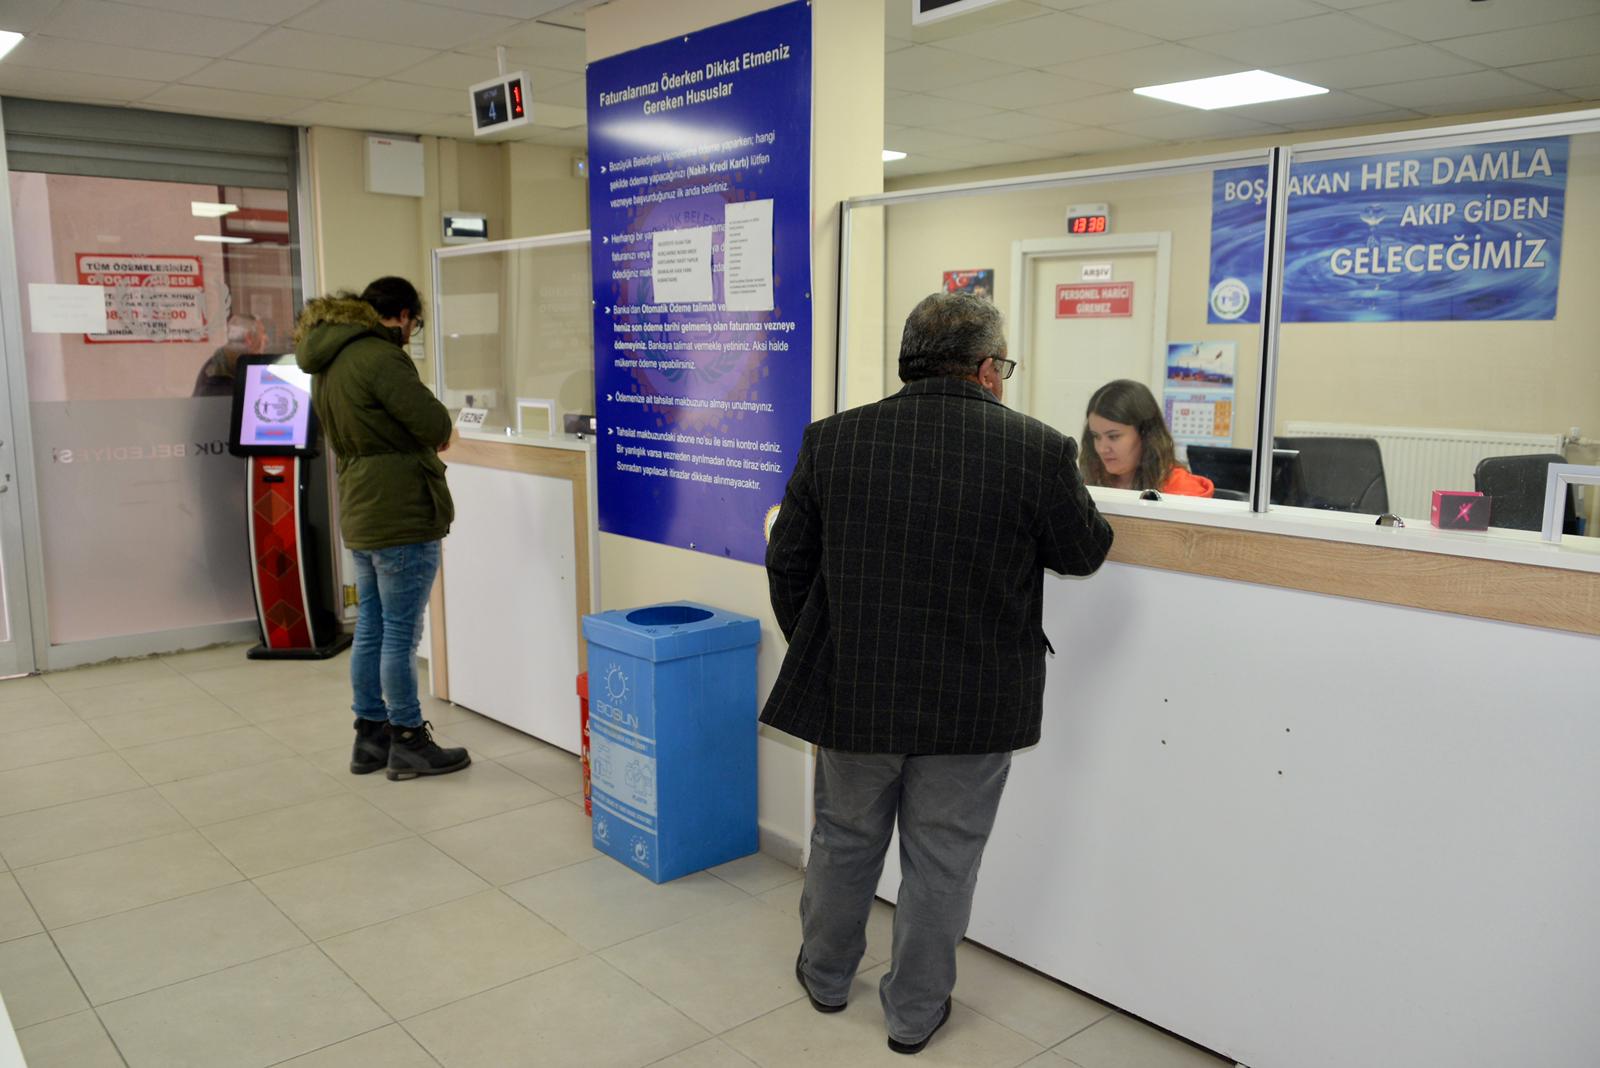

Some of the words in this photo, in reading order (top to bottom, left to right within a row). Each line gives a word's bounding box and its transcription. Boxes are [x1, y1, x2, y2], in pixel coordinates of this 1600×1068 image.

[600, 81, 659, 107] Faturalarınızı
[661, 70, 703, 91] Öderken
[706, 57, 740, 79] Dikkat
[743, 43, 790, 69] Etmeniz
[644, 95, 683, 115] Gereken
[686, 82, 733, 105] Hususlar
[489, 101, 496, 120] 4
[755, 129, 776, 144] hangi
[710, 159, 728, 173] Kredi
[750, 153, 770, 167] lütfen
[1225, 178, 1269, 205] BOŞ
[1287, 171, 1350, 196] AKAN
[1361, 159, 1421, 191] HER
[1432, 148, 1553, 186] DAMLA
[685, 185, 700, 197] anda
[1400, 203, 1456, 227] AKIP
[1464, 193, 1549, 224] GİDEN
[636, 231, 644, 242] bir
[637, 250, 650, 262] veya
[1330, 232, 1546, 276] GELECEĞİMİZ
[1060, 289, 1099, 300] PERSONEL
[642, 303, 668, 314] Otomatik
[669, 302, 691, 313] Ödeme
[632, 323, 642, 332] son
[643, 322, 663, 332] ödeme
[664, 321, 680, 332] tarihi
[681, 321, 712, 333] gelmemiş
[713, 321, 728, 331] olan
[764, 321, 795, 333] vezneye
[648, 340, 672, 352] Bankaya
[673, 340, 693, 351] talimat
[752, 341, 767, 351] Aksi
[769, 340, 789, 352] halde
[638, 358, 657, 368] ödeme
[615, 391, 645, 403] Ödemenize
[654, 395, 674, 405] tahsilat
[675, 395, 708, 408] makbuzunu
[710, 399, 730, 411] almayı
[732, 401, 774, 413] unutmayınız.
[616, 426, 636, 438] Tahsilat
[637, 429, 675, 442] makbuzundaki
[677, 433, 695, 445] abone
[713, 436, 721, 447] ile
[722, 437, 735, 448] ismi
[736, 438, 759, 450] kontrol
[760, 442, 782, 453] ediniz.
[616, 444, 624, 453] Bir
[647, 449, 662, 458] varsa
[663, 450, 690, 462] vezneden
[726, 457, 742, 468] önce
[743, 458, 759, 470] itiraz
[760, 461, 782, 473] ediniz.
[616, 461, 642, 473] Sonradan
[691, 471, 712, 483] dikkate
